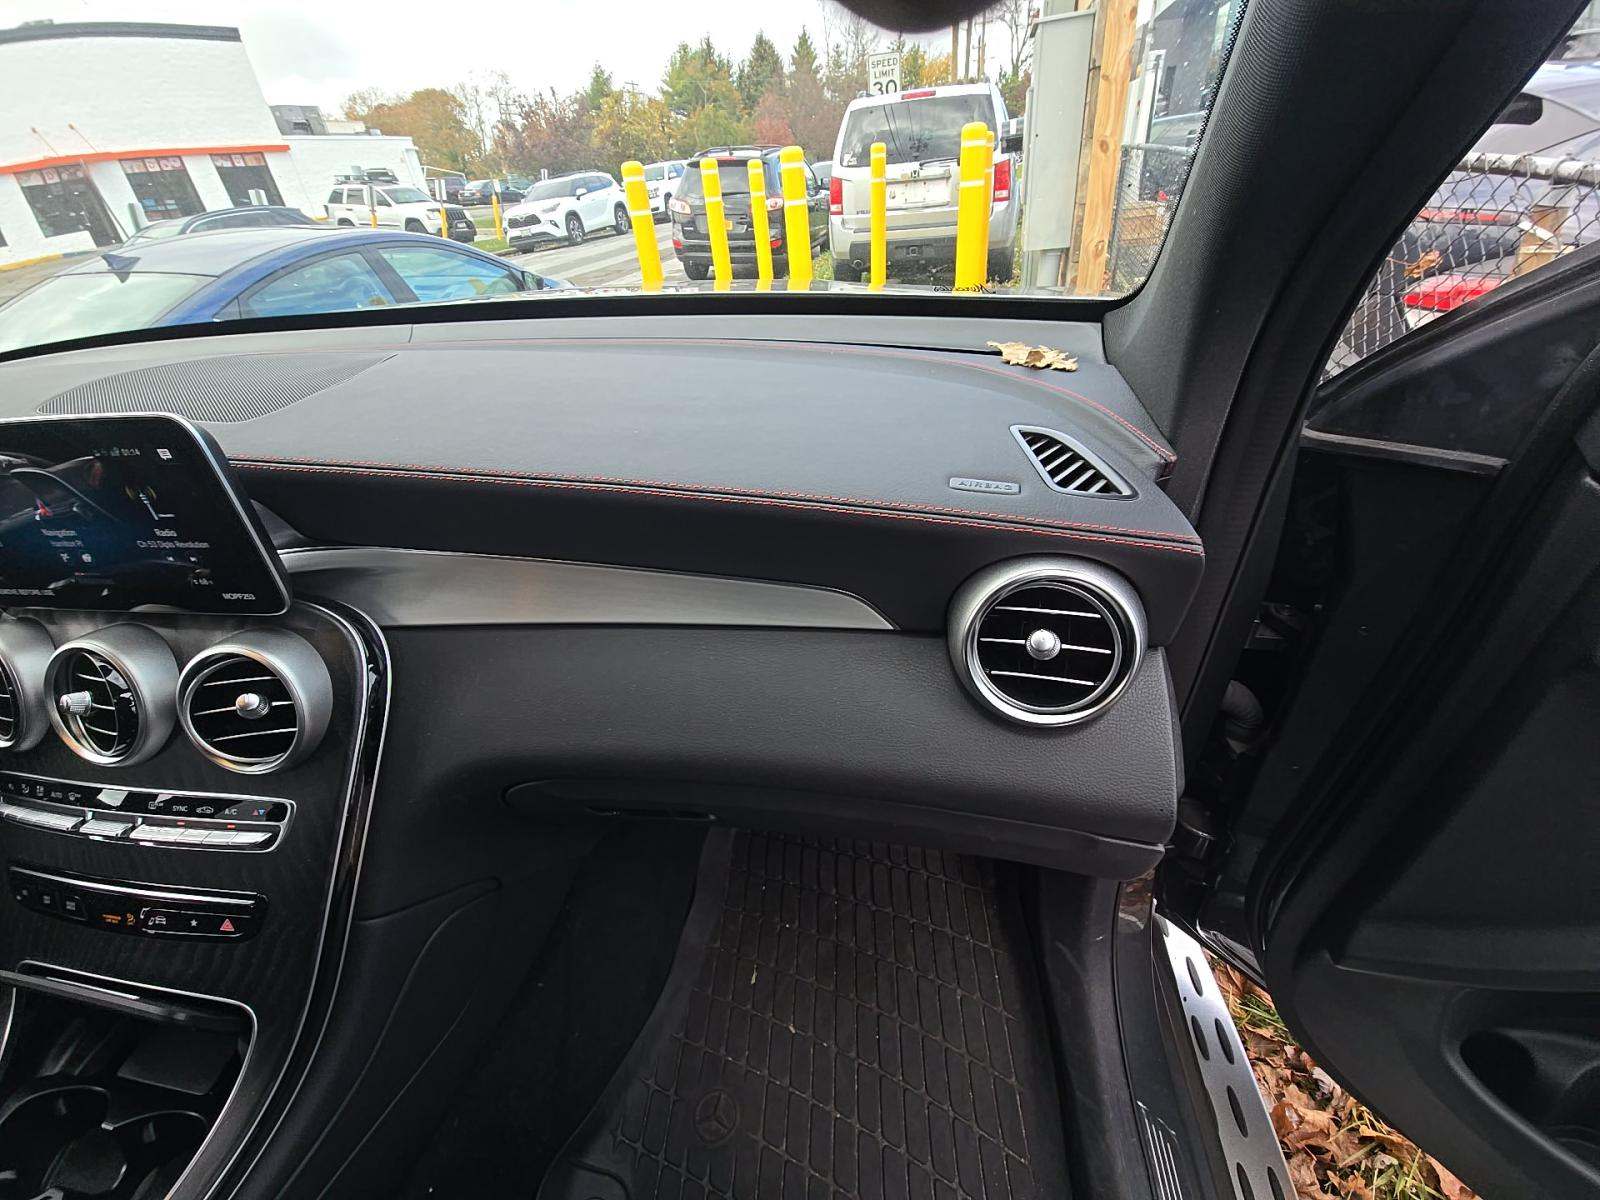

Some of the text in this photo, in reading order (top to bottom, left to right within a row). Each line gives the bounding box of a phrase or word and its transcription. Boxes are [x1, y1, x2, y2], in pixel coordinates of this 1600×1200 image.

[871, 57, 898, 69] SPEED
[874, 68, 895, 79] LIMIT
[873, 79, 897, 95] 30
[958, 481, 1013, 491] AIRBAG
[154, 528, 177, 537] Radio
[224, 808, 238, 816] A/C
